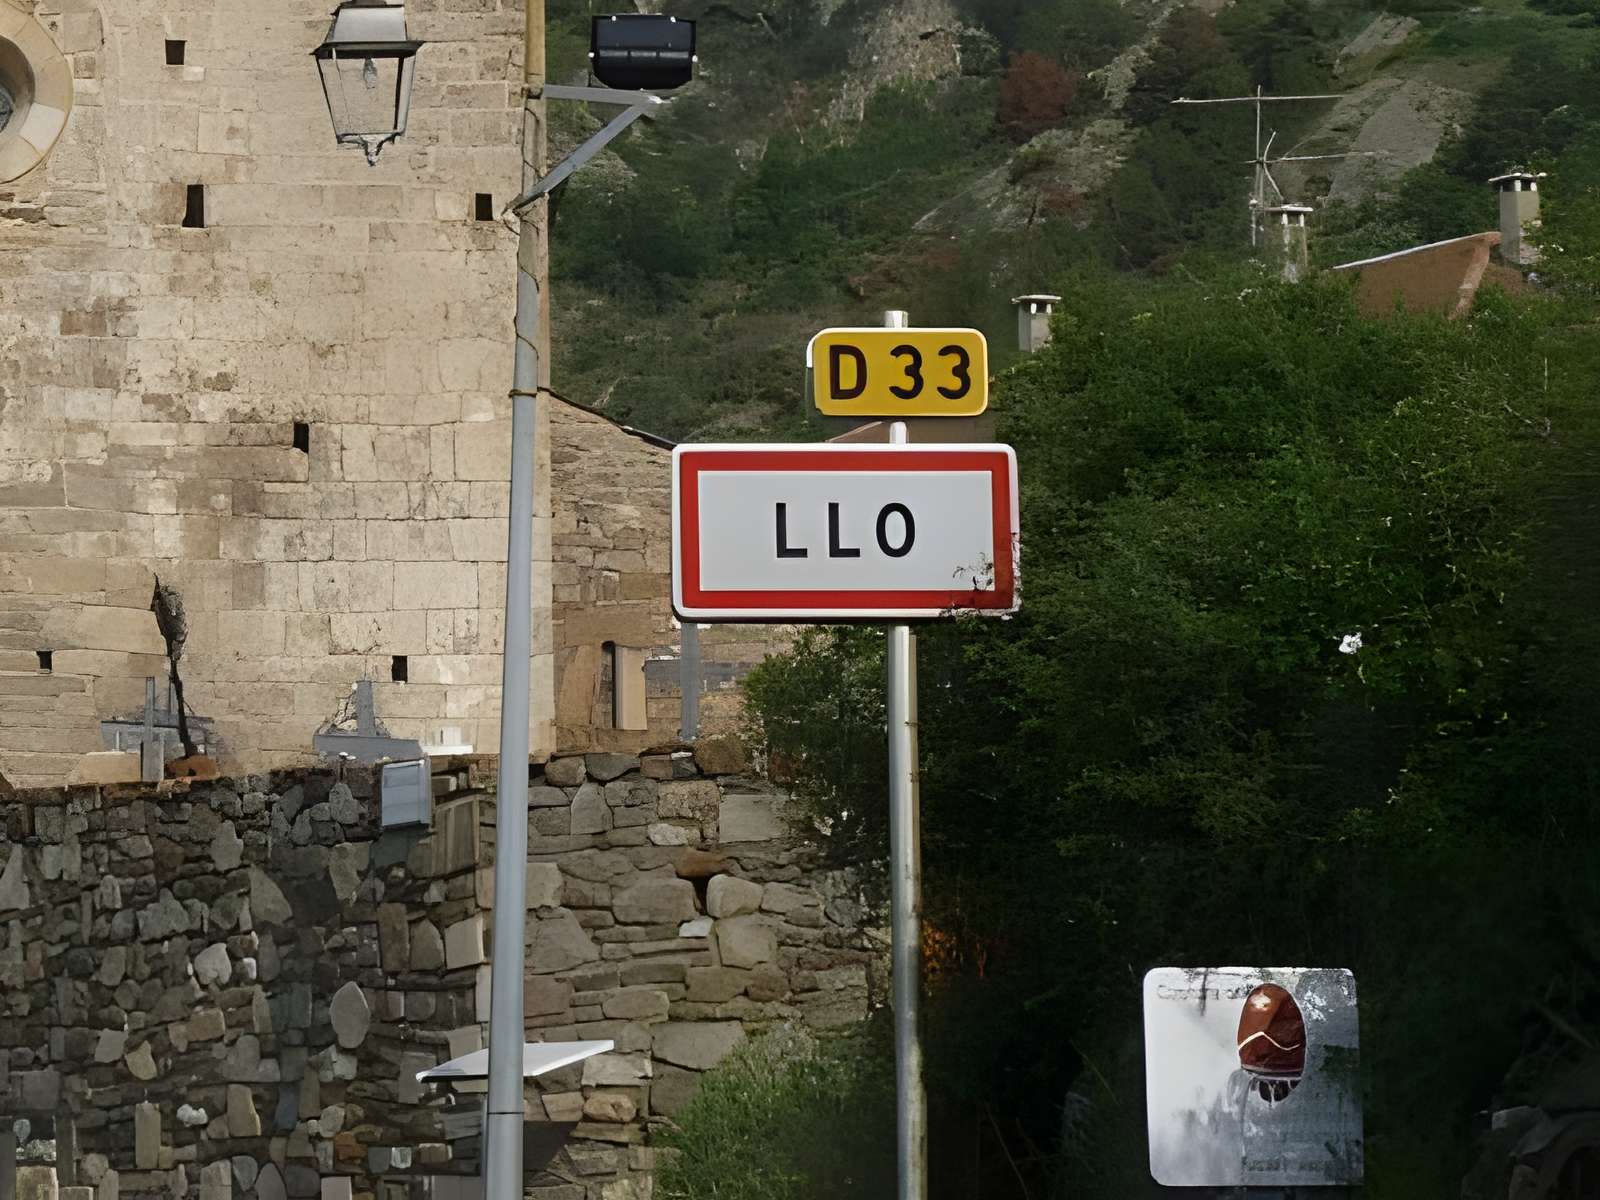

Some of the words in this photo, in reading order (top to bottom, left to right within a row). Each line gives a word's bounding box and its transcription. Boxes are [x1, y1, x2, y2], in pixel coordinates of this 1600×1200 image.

[829, 344, 868, 400] D
[888, 344, 972, 400] 33
[775, 502, 916, 558] LLO
